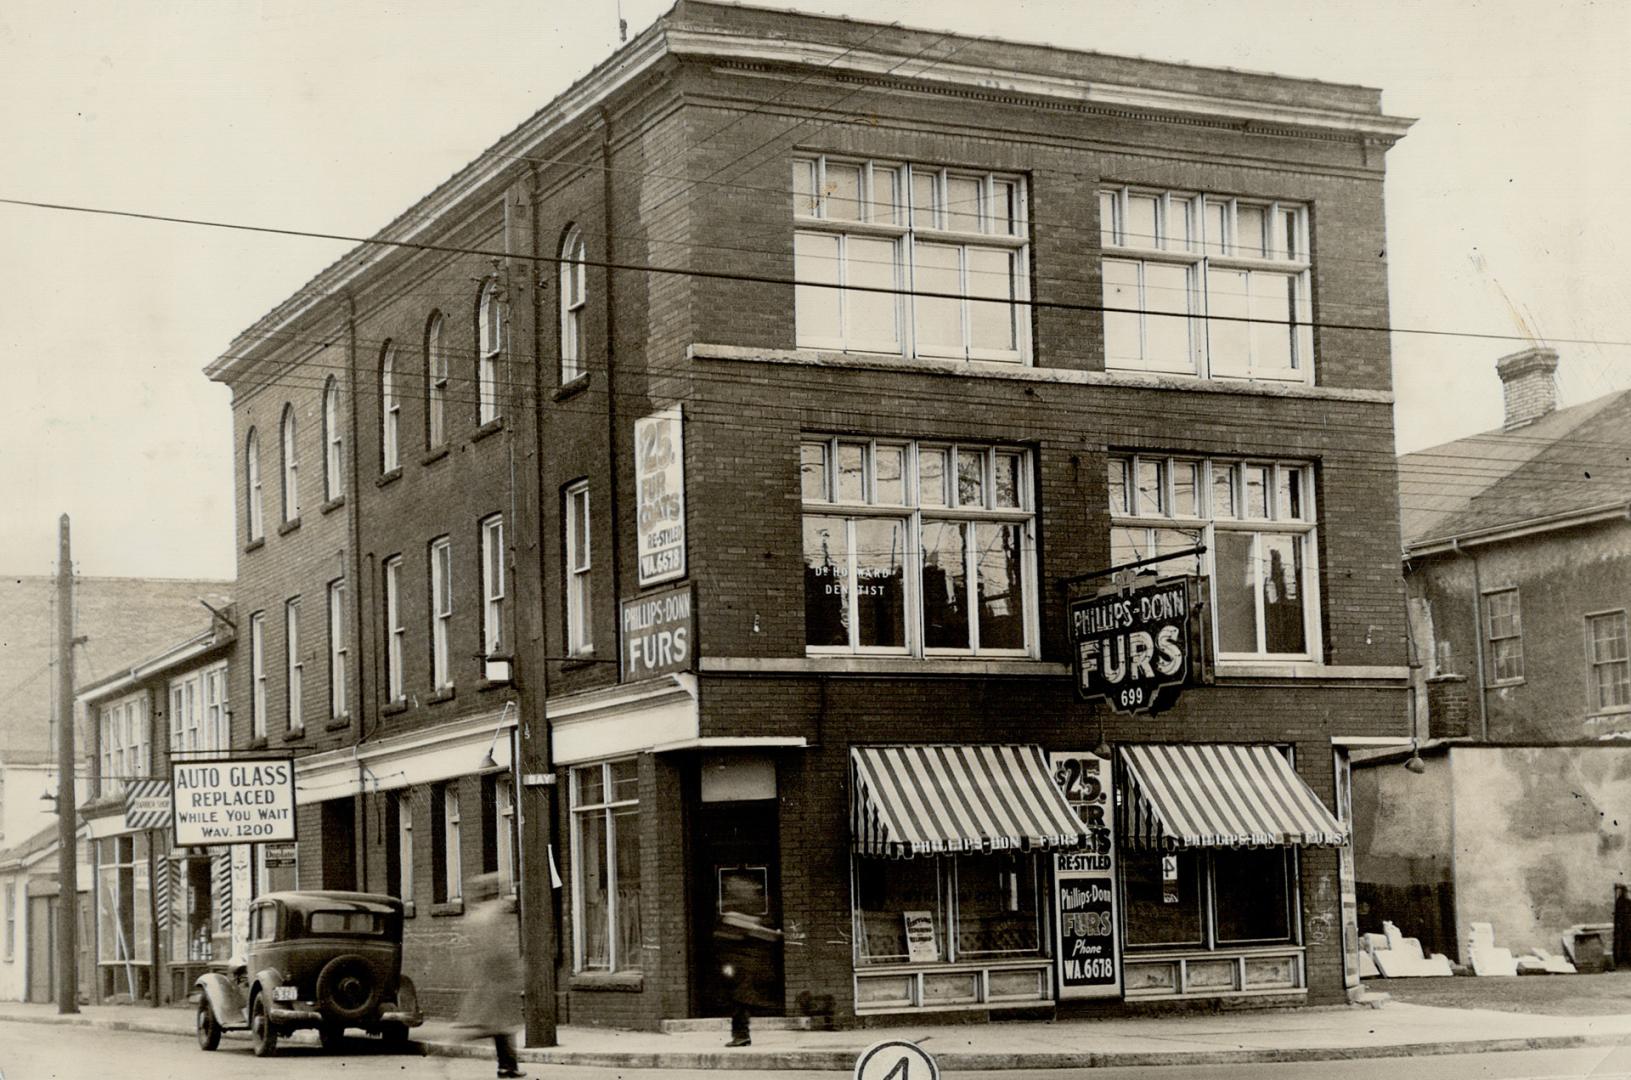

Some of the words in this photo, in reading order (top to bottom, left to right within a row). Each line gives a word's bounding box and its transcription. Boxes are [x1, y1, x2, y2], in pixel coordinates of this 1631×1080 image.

[647, 525, 683, 549] RE-STYLED
[825, 584, 885, 596] DENTIST
[624, 592, 690, 633] PHILLIPS-DONN
[1073, 589, 1184, 637] PHILLIPS-DONN
[629, 627, 687, 672] FURS
[1080, 624, 1183, 689] FURS
[1121, 687, 1143, 707] 699
[177, 768, 220, 789] AUTO
[229, 766, 288, 788] GLASS
[528, 774, 551, 785] BAY
[192, 790, 275, 808] REPLACED
[179, 811, 219, 824] WHILE
[226, 809, 251, 822] YOU
[257, 808, 289, 820] WAIT
[237, 823, 274, 837] 1200
[1058, 855, 1111, 871] RE-STYLED
[1063, 911, 1112, 937] FURS
[1072, 939, 1102, 957] Phone
[1064, 958, 1113, 980] WA.6678
